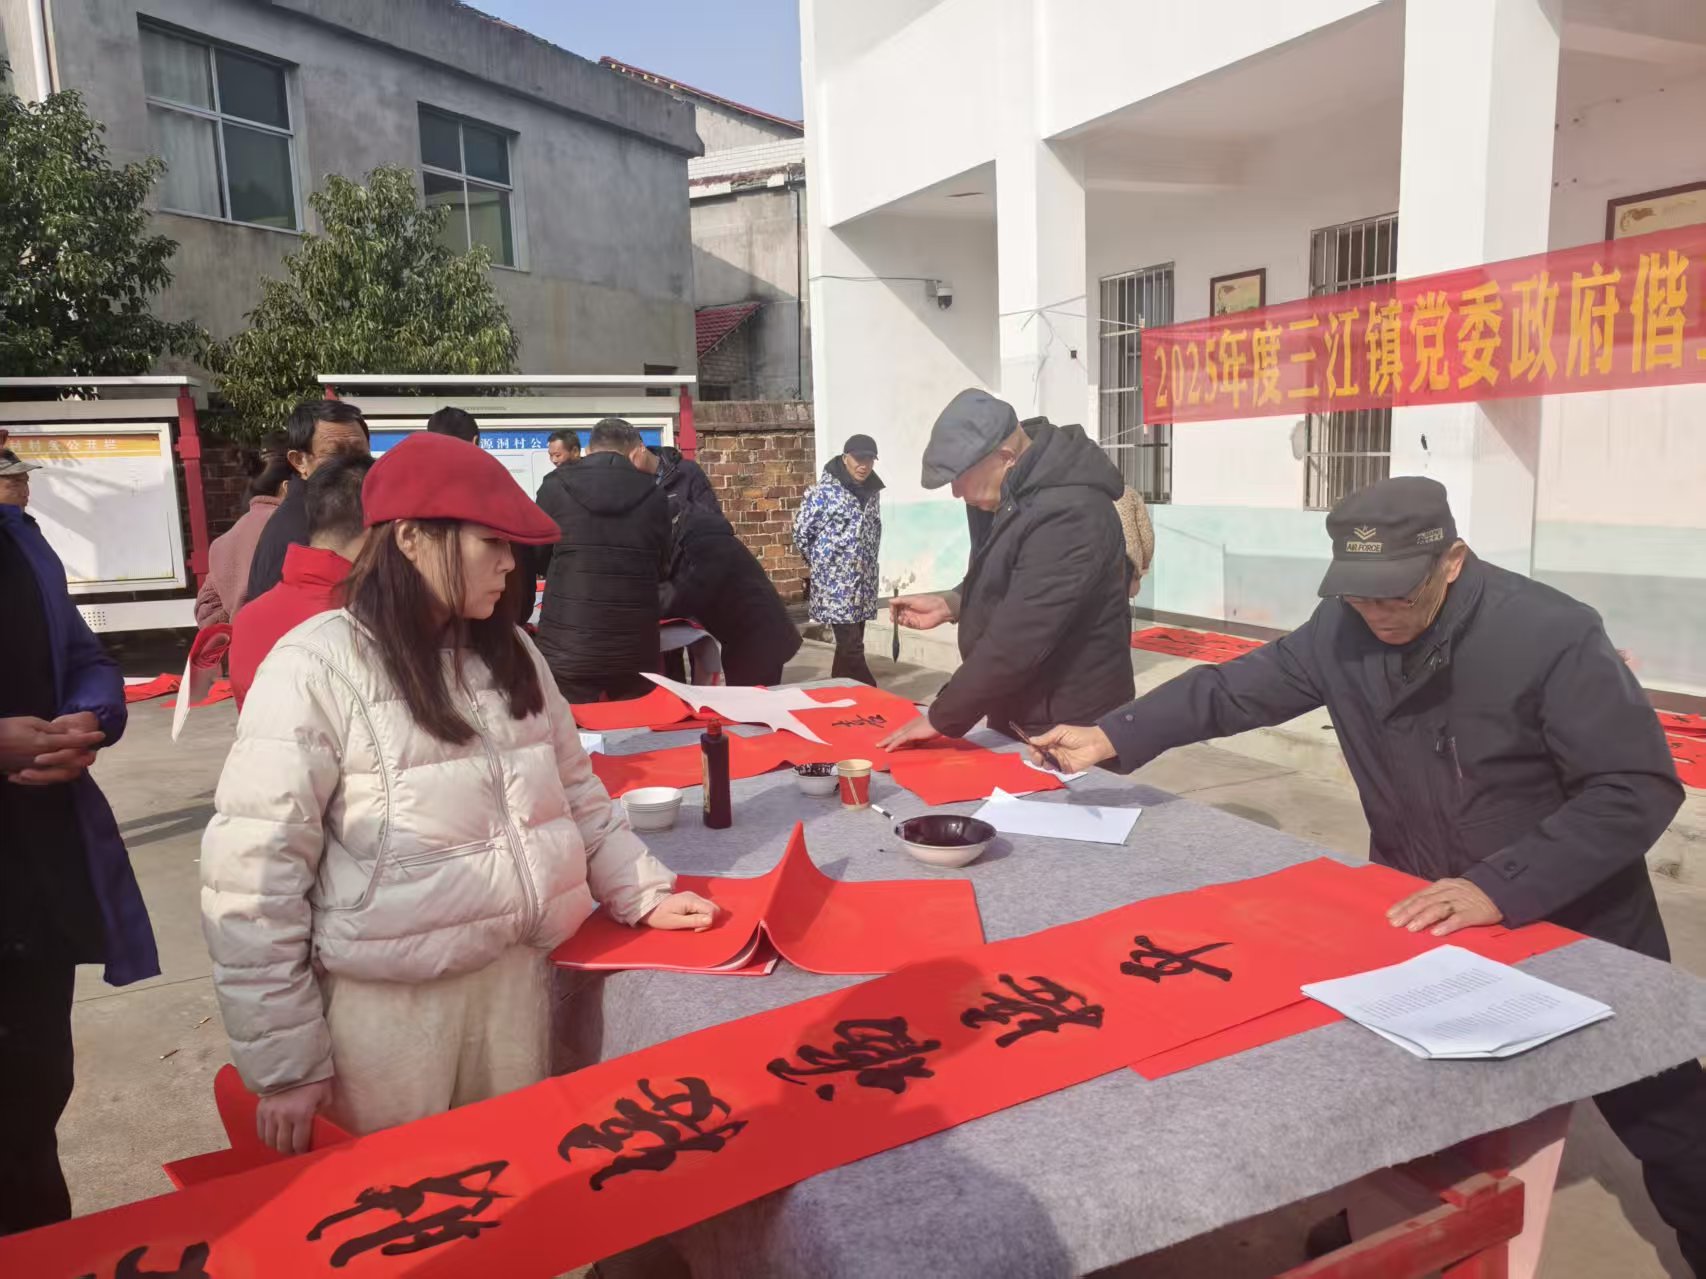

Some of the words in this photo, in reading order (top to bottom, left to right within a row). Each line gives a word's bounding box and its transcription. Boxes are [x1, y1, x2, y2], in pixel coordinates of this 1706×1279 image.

[1154, 248, 1706, 410] 2025年度三江镇党委政府偕
[480, 437, 549, 449] 源洞村公
[1347, 543, 1358, 551] AIR
[1358, 544, 1381, 552] FORCE
